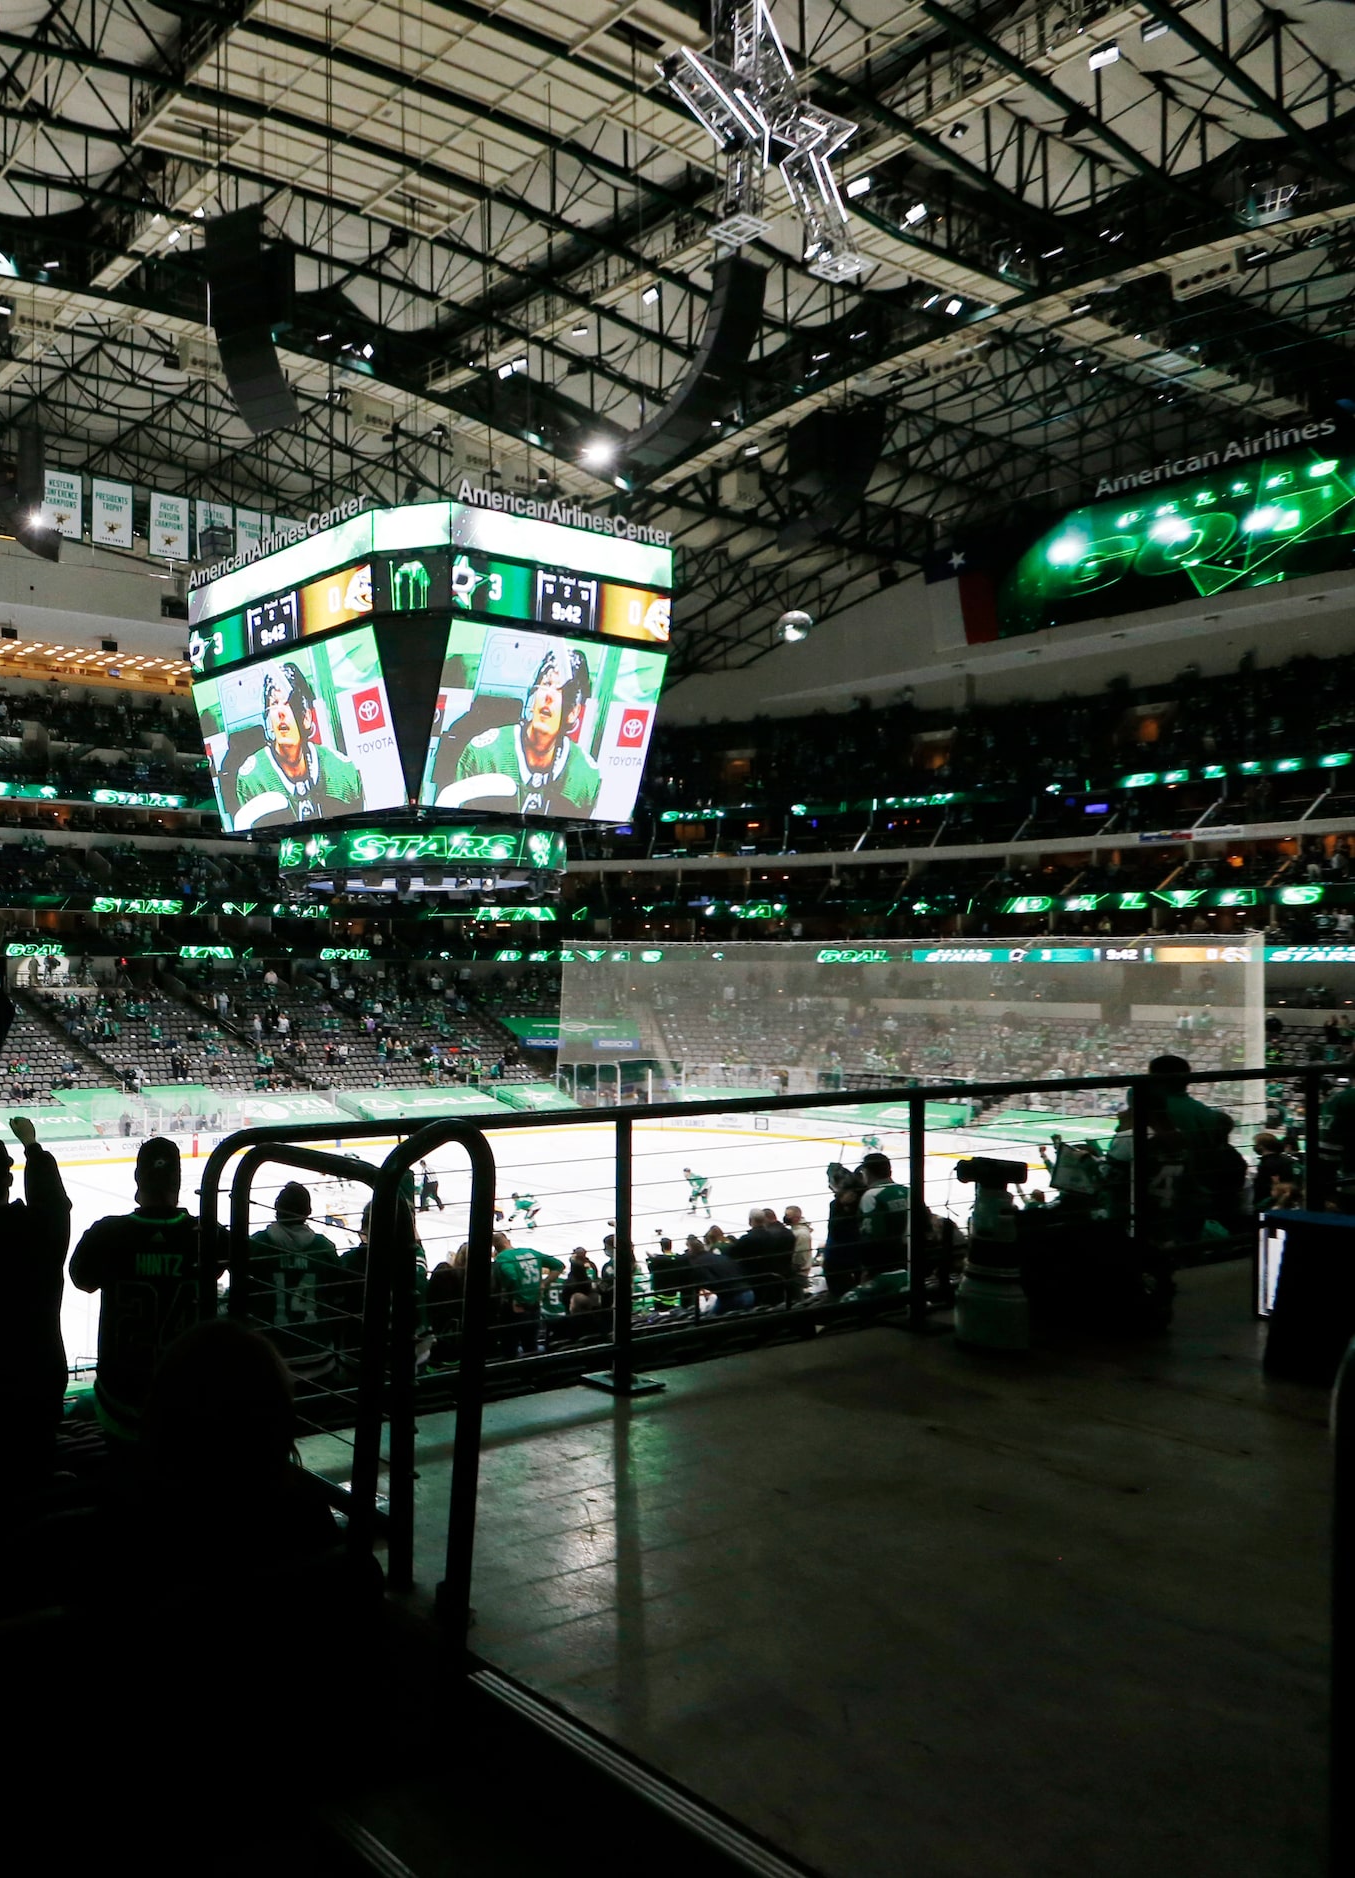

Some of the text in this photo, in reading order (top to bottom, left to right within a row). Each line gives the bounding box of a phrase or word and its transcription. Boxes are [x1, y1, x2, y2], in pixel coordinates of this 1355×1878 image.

[1095, 416, 1336, 498] American Airlines
[48, 479, 74, 491] WESTERN
[45, 496, 77, 509] CHAMPIONS
[102, 501, 123, 513] TROPHY
[159, 502, 179, 513] PACIFIC
[158, 510, 180, 522] DIVISION
[154, 519, 184, 531] CHAMPIONS
[489, 573, 503, 601] 3
[563, 585, 572, 599] 2
[328, 586, 341, 613] 0
[268, 609, 275, 621] 2
[551, 601, 582, 625] 9:42
[628, 600, 642, 626] 0
[260, 622, 286, 647] 9:42
[213, 632, 224, 655] 3
[356, 738, 394, 755] TOYOTA
[608, 756, 643, 767] TOYOTA
[94, 789, 186, 808] STARS
[349, 834, 518, 861] STARS
[92, 897, 184, 915] STARS
[6, 942, 66, 957] GOAL
[319, 947, 372, 961] GOAL
[1106, 948, 1138, 961] 9:42
[816, 950, 887, 964] GOAL
[925, 952, 992, 962] STARS
[526, 1038, 559, 1047] GEICO
[598, 1040, 633, 1048] GEICO
[278, 1099, 332, 1110] TXU
[294, 1107, 340, 1117] energy
[134, 1253, 183, 1278] HINTZ
[272, 1271, 317, 1325] 14
